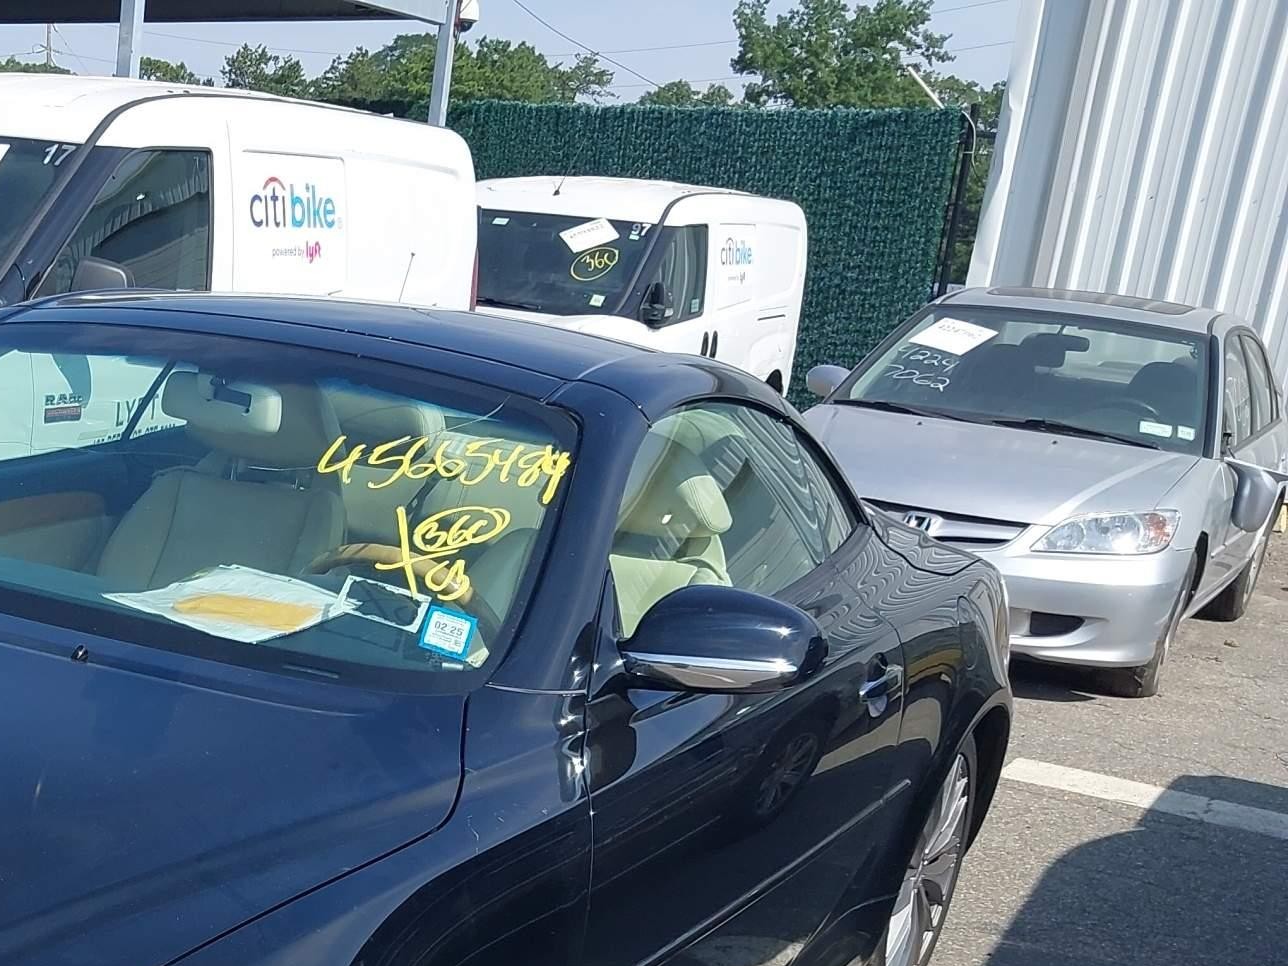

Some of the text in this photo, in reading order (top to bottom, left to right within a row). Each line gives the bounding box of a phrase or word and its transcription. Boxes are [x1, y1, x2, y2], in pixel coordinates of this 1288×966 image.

[43, 143, 77, 166] 17
[249, 177, 336, 228] citi bike
[631, 223, 652, 236] 97
[272, 247, 297, 258] powered
[305, 241, 321, 264] lyft
[898, 345, 960, 372] 4224
[884, 364, 950, 392] 7062
